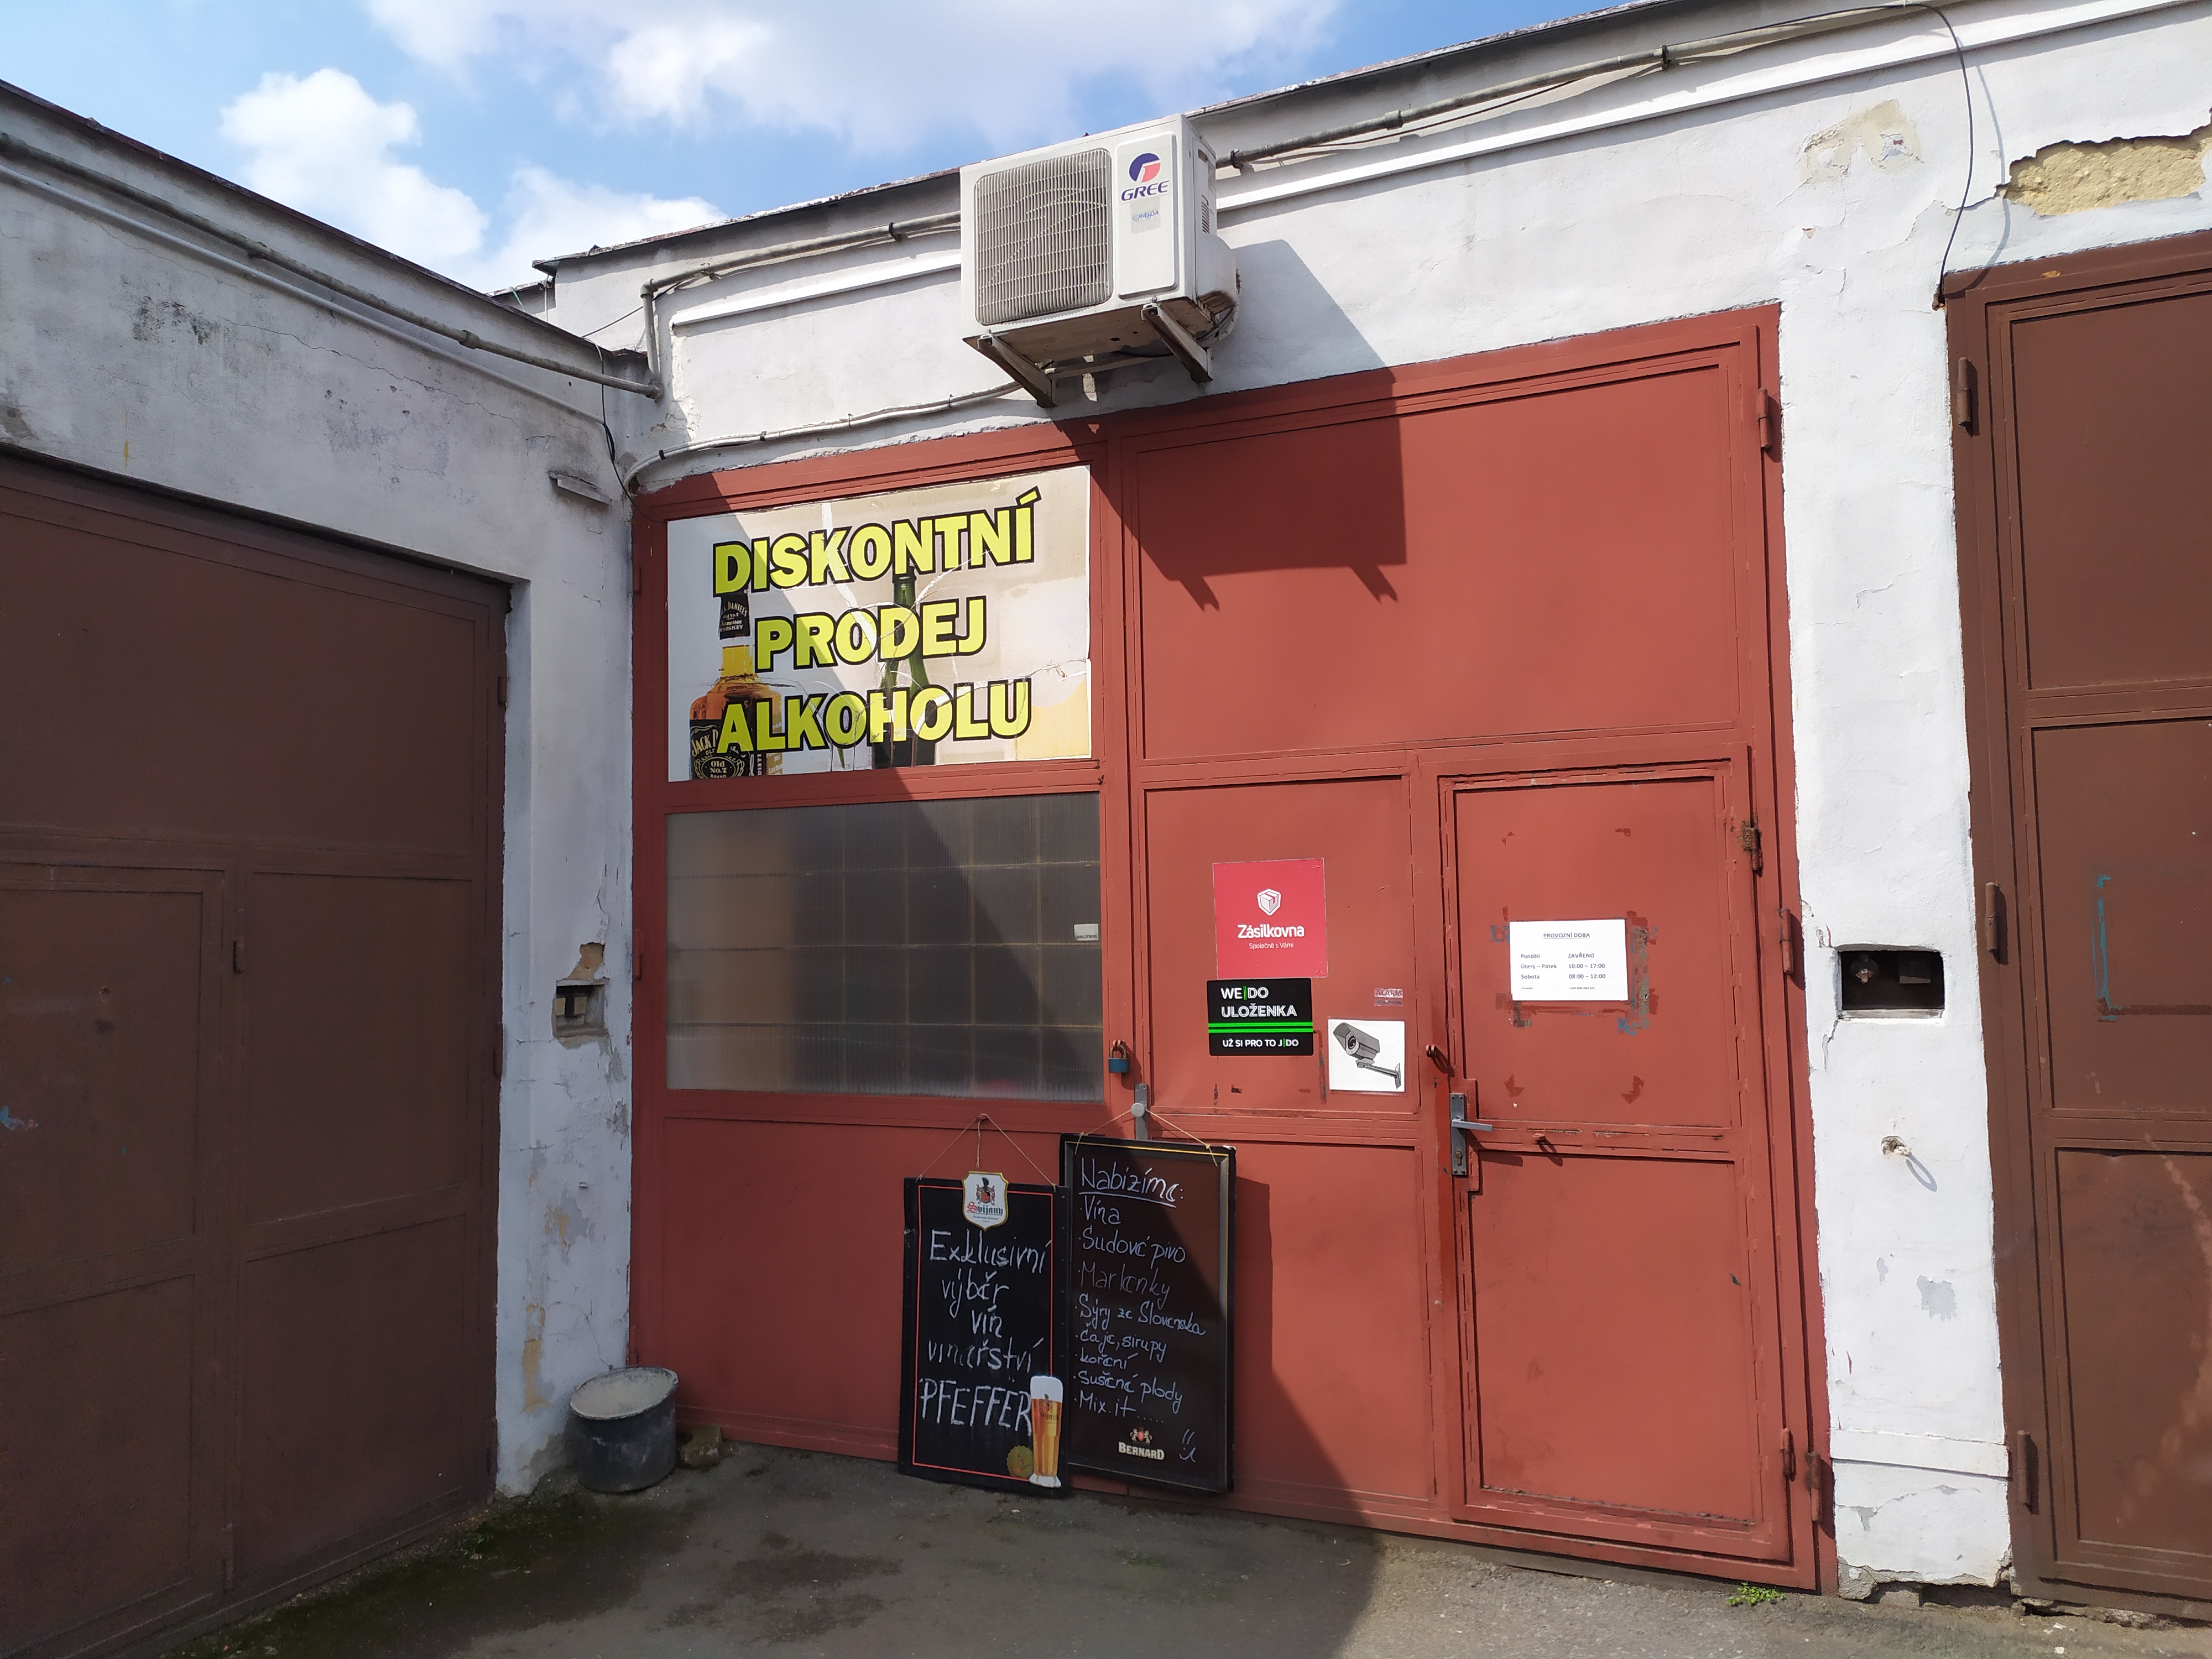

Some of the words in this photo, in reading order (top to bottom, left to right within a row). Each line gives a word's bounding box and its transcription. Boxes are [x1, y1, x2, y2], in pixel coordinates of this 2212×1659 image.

[1121, 180, 1170, 201] GREE
[713, 486, 1041, 597] DISKONTNÍ
[755, 596, 986, 672] PRODEJ
[718, 679, 1031, 754] ALKOHOLU
[692, 734, 713, 757] JACK
[1237, 924, 1305, 939] Zásilkovna
[1221, 1003, 1297, 1018] ULOŽENKA
[1223, 1038, 1234, 1047] UŽ
[967, 1201, 1003, 1216] Svijany
[1084, 1195, 1121, 1224] Vína
[930, 1228, 1052, 1274] Exklusivní
[1082, 1225, 1150, 1257] Sudové
[1150, 1241, 1186, 1269] pivo
[942, 1268, 1010, 1318] výběr
[1080, 1261, 1171, 1310] Marlenky
[972, 1305, 1002, 1338] vín
[1079, 1293, 1110, 1330] Sýry
[1117, 1308, 1133, 1319] ze
[1121, 1334, 1167, 1363] sirupy
[919, 1378, 1032, 1437] PFEFFER
[1078, 1370, 1138, 1392] Sušené
[1140, 1377, 1182, 1414] plody
[1118, 1442, 1165, 1460] BERNARD
